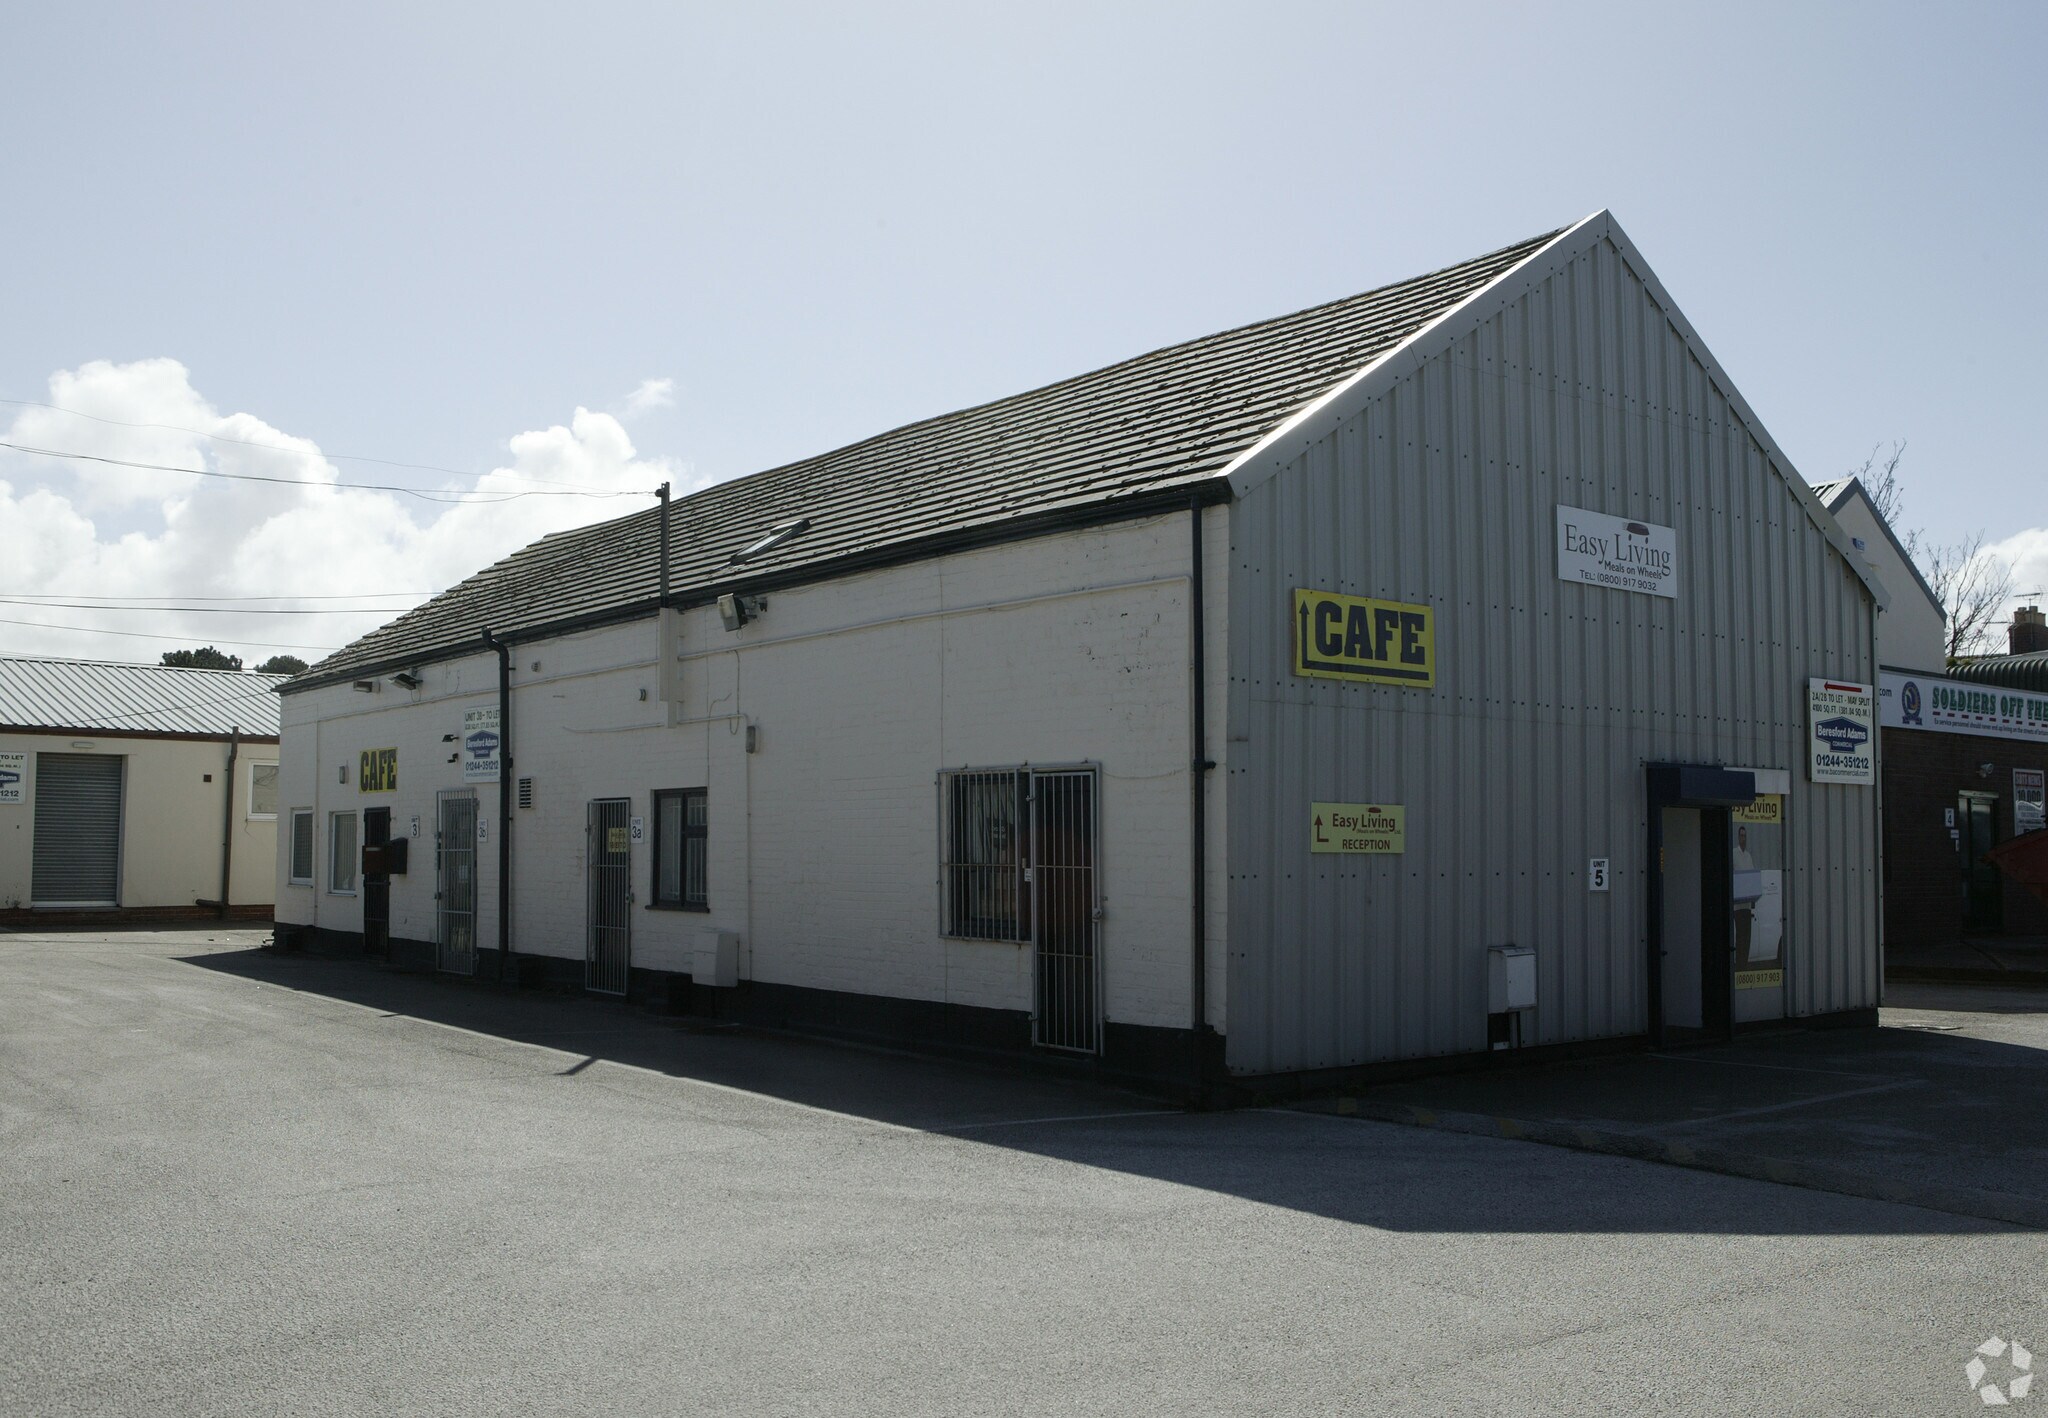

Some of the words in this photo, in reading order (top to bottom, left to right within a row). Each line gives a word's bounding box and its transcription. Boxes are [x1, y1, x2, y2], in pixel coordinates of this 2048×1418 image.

[1565, 524, 1608, 564] Easy
[1614, 534, 1670, 576] Living
[1604, 560, 1624, 574] Meals
[1637, 566, 1662, 580] Wheels
[1597, 574, 1621, 585] (0800)
[1623, 577, 1636, 586] 917
[1638, 580, 1656, 591] 9032
[1315, 601, 1425, 665] CAFE
[1812, 692, 1828, 702] 2A/2B
[1828, 694, 1835, 702] TO
[1848, 696, 1857, 704] MAY
[1858, 698, 1870, 706] SPLIT
[1879, 688, 1892, 697] com
[1932, 686, 1997, 715] SOLDIERS
[2000, 695, 2024, 718] OFF
[2027, 698, 2048, 722] THE
[465, 712, 475, 722] UNIT
[486, 710, 492, 720] TO
[1818, 725, 1846, 738] Beresford
[1847, 727, 1866, 740] Adams
[465, 760, 498, 771] 01244-351212
[1816, 754, 1869, 769] 01244-351212
[360, 749, 396, 792] CAFE
[1817, 768, 1869, 777] www.bacommercial.com
[1333, 813, 1359, 831] Easy
[1362, 814, 1396, 832] Living
[1948, 815, 1952, 824] 4
[412, 824, 417, 836] 3
[632, 826, 641, 838] 3a
[1342, 839, 1391, 850] RECEPTION
[1595, 870, 1603, 886] 5
[1736, 974, 1755, 985] (0800)
[1756, 974, 1767, 983] 917
[1768, 972, 1780, 982] 903
